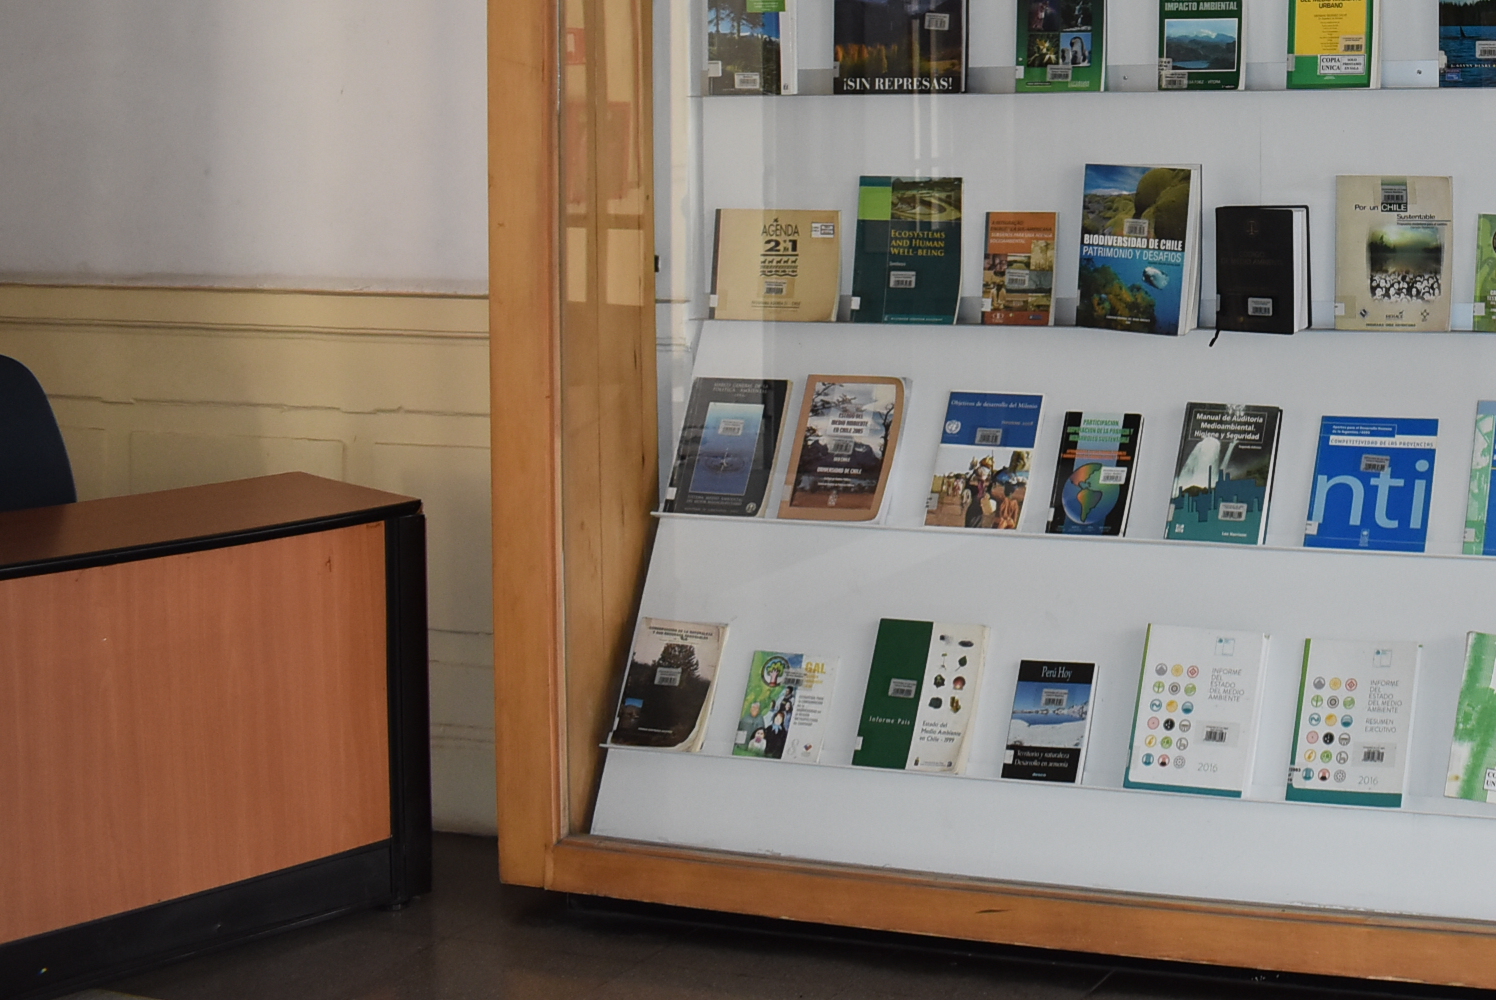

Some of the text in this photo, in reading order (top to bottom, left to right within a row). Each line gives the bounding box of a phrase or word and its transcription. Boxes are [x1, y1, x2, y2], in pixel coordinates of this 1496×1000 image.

[1164, 1, 1238, 11] IMPACTO AMBIENTAL
[843, 77, 953, 91] ¡SIN REPRESAS!
[1354, 203, 1367, 211] Por
[1381, 203, 1407, 212] CHILE
[761, 223, 800, 237] AGENDA
[1083, 234, 1183, 251] BIODIVERSIDAD DE CHILE
[1082, 246, 1134, 259] PATRIMONIO
[1135, 249, 1142, 259] Y
[1196, 413, 1221, 421] Manual
[1194, 430, 1220, 439] Higiene
[1226, 431, 1260, 440] Seguridad
[1312, 458, 1430, 530] nti
[1041, 665, 1073, 681] Perú Hoy
